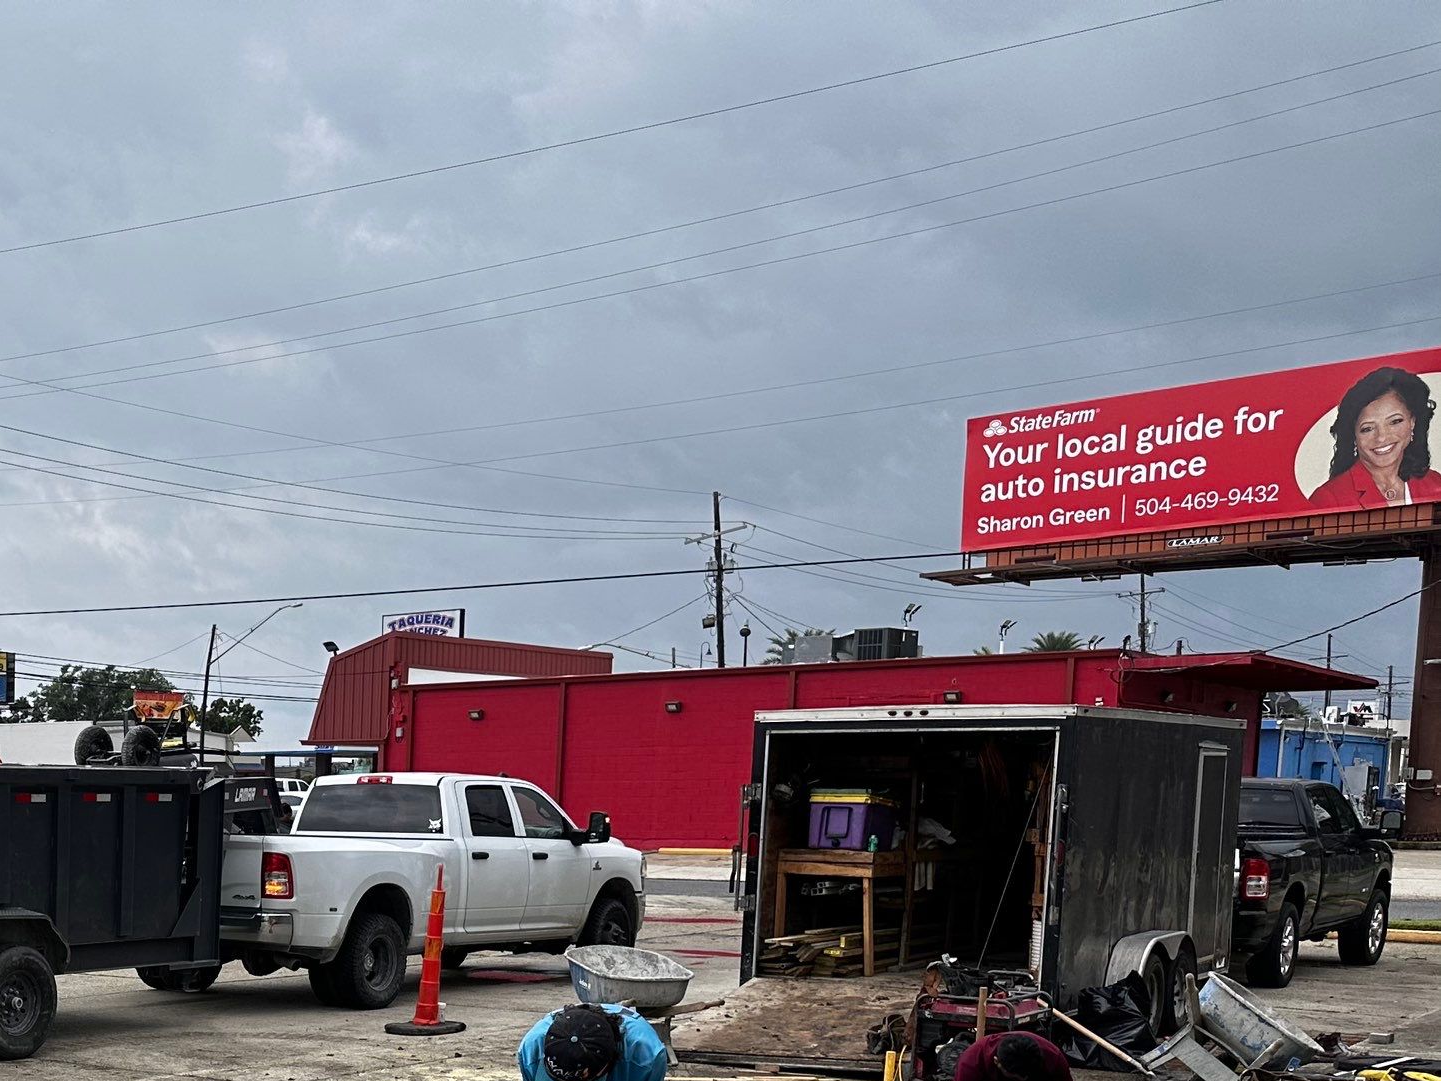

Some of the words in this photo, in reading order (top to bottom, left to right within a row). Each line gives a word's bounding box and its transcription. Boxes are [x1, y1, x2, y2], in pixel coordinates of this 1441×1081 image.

[983, 442, 1048, 469] Your
[1057, 424, 1127, 459] local
[1135, 413, 1224, 454] guide
[1234, 406, 1284, 435] for
[980, 473, 1045, 502] auto
[1053, 456, 1207, 494] insurance
[977, 515, 1044, 534] Sharon
[1049, 506, 1110, 526] Green
[1135, 484, 1279, 517] 504-469-9432
[1172, 536, 1218, 546] LAMAR
[388, 614, 455, 631] TAQUERIA
